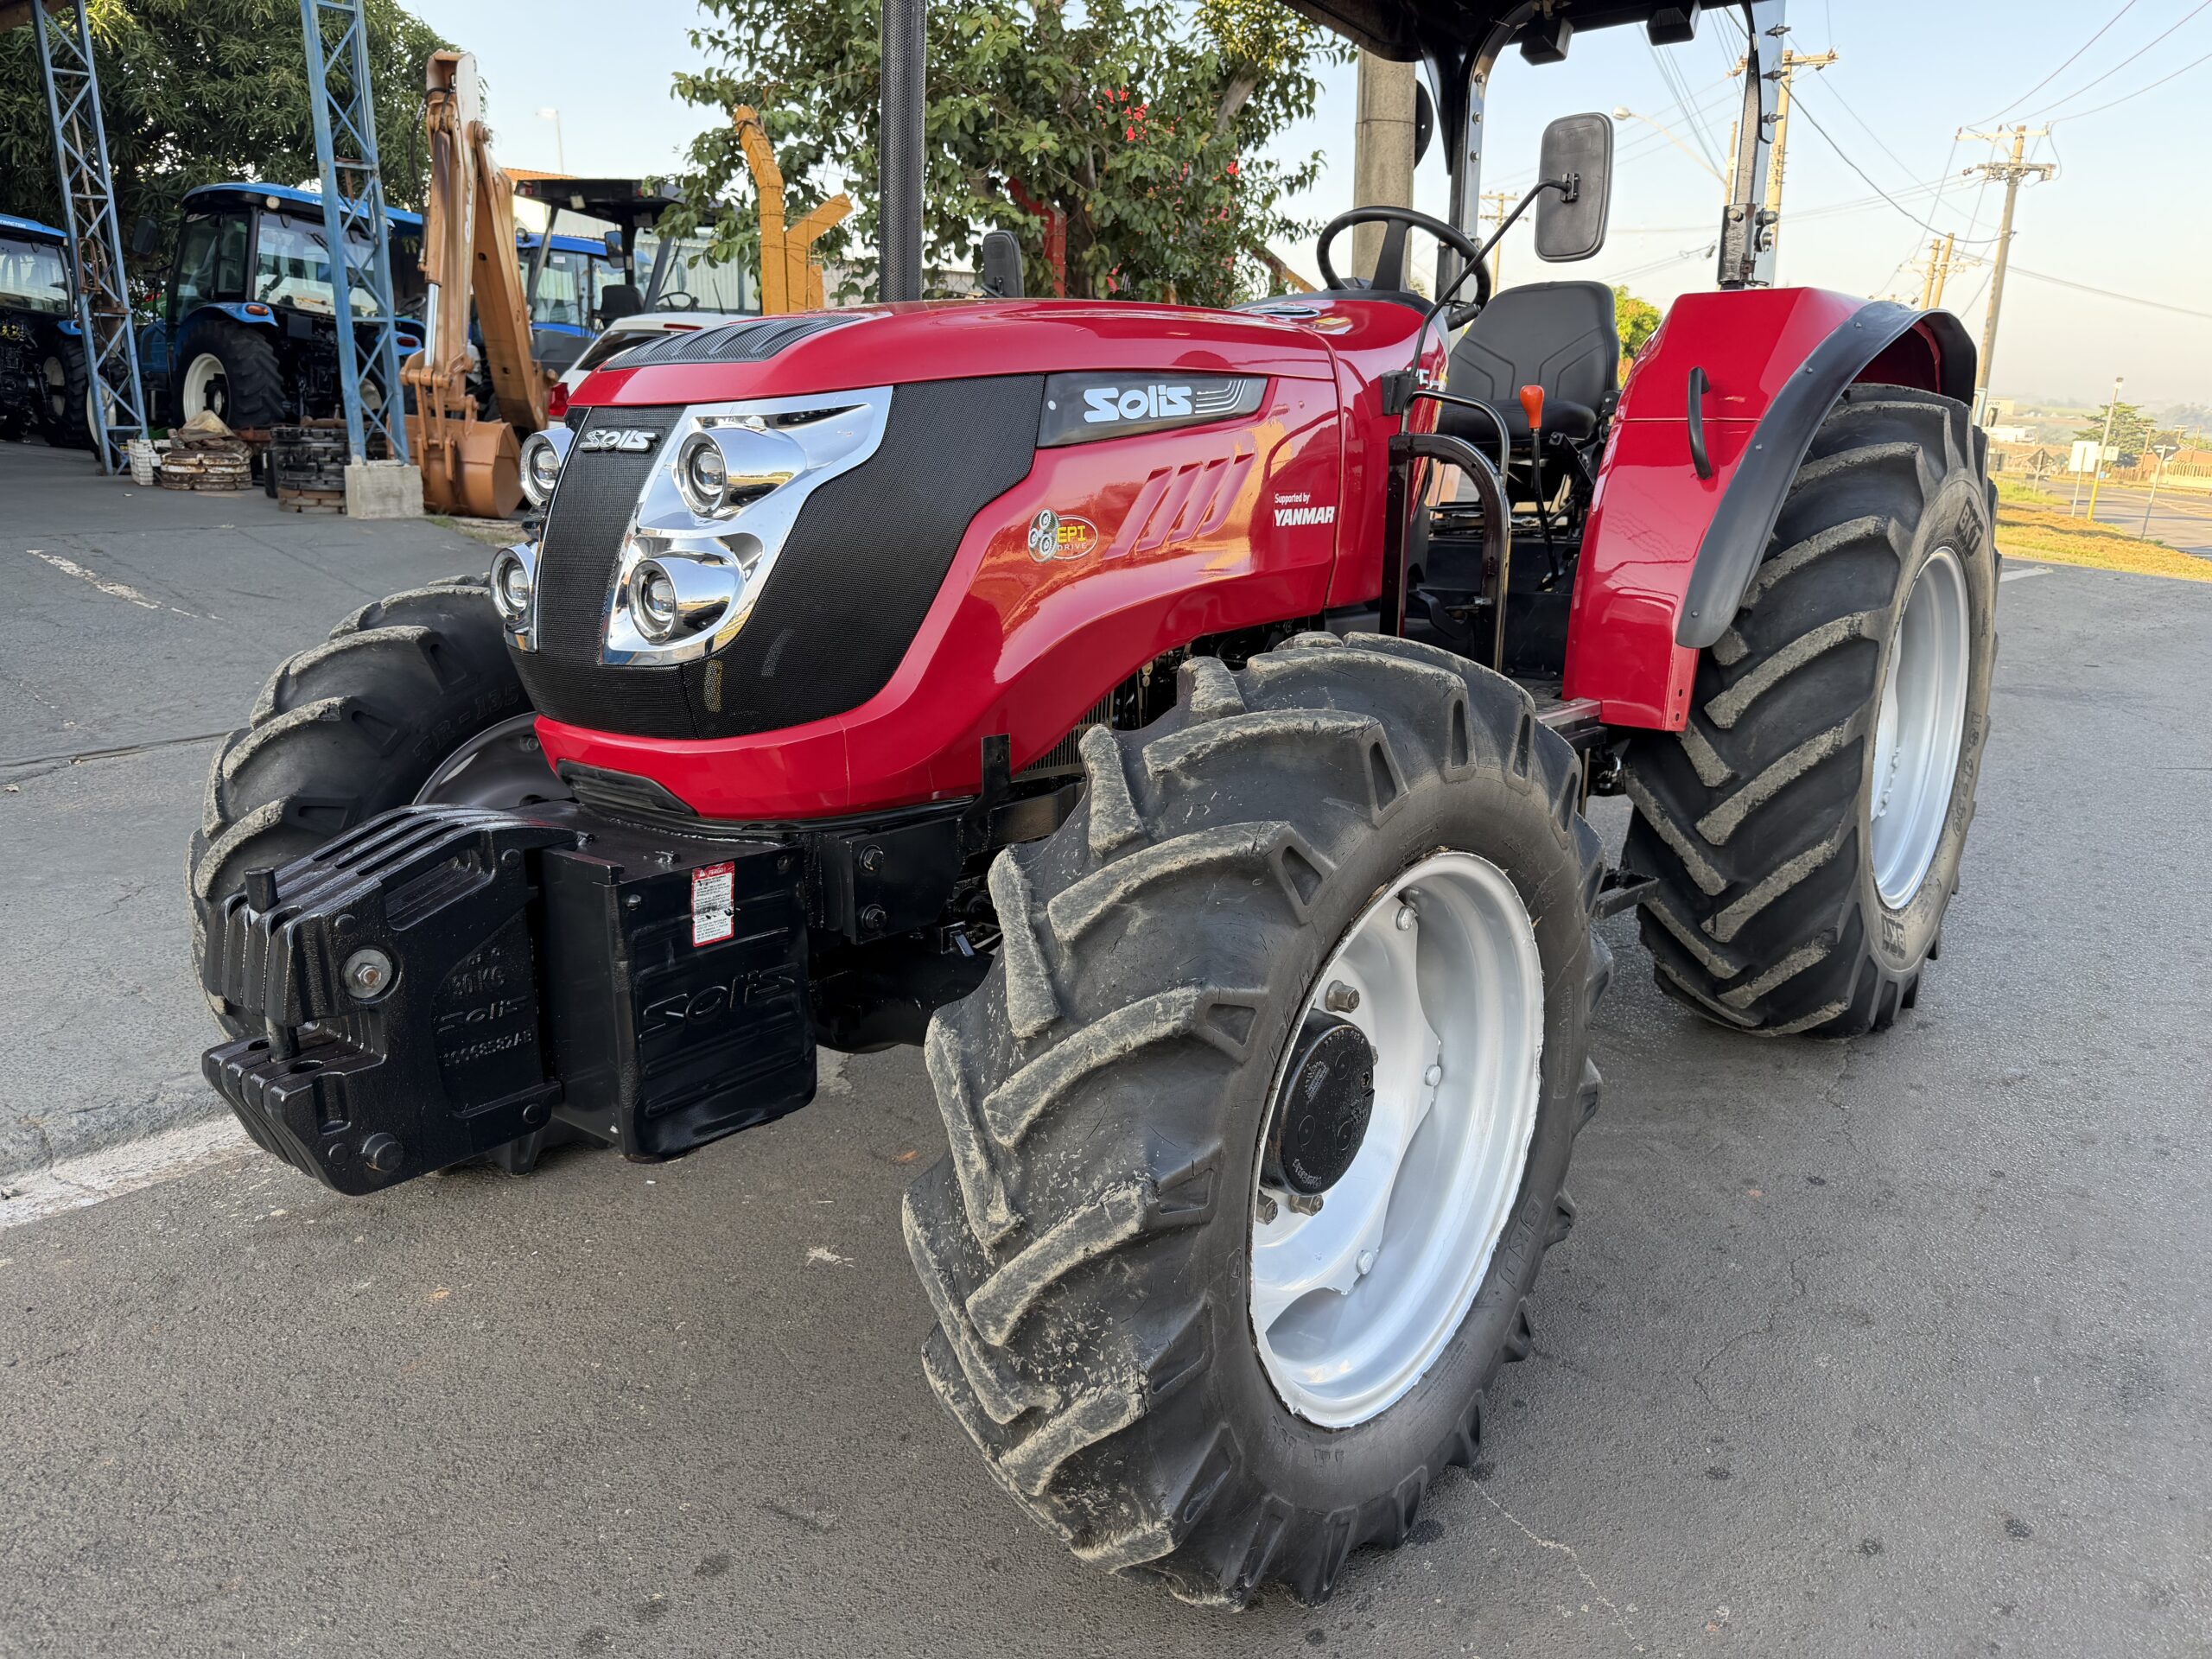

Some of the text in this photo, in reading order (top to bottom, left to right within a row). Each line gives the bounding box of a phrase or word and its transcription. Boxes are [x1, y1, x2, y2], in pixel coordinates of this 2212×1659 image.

[1274, 492, 1311, 505] Supported by
[1274, 506, 1335, 526] YANMAR
[1057, 525, 1086, 543] EPI
[1955, 498, 1984, 555] BKT
[1058, 543, 1087, 551] DRIVE
